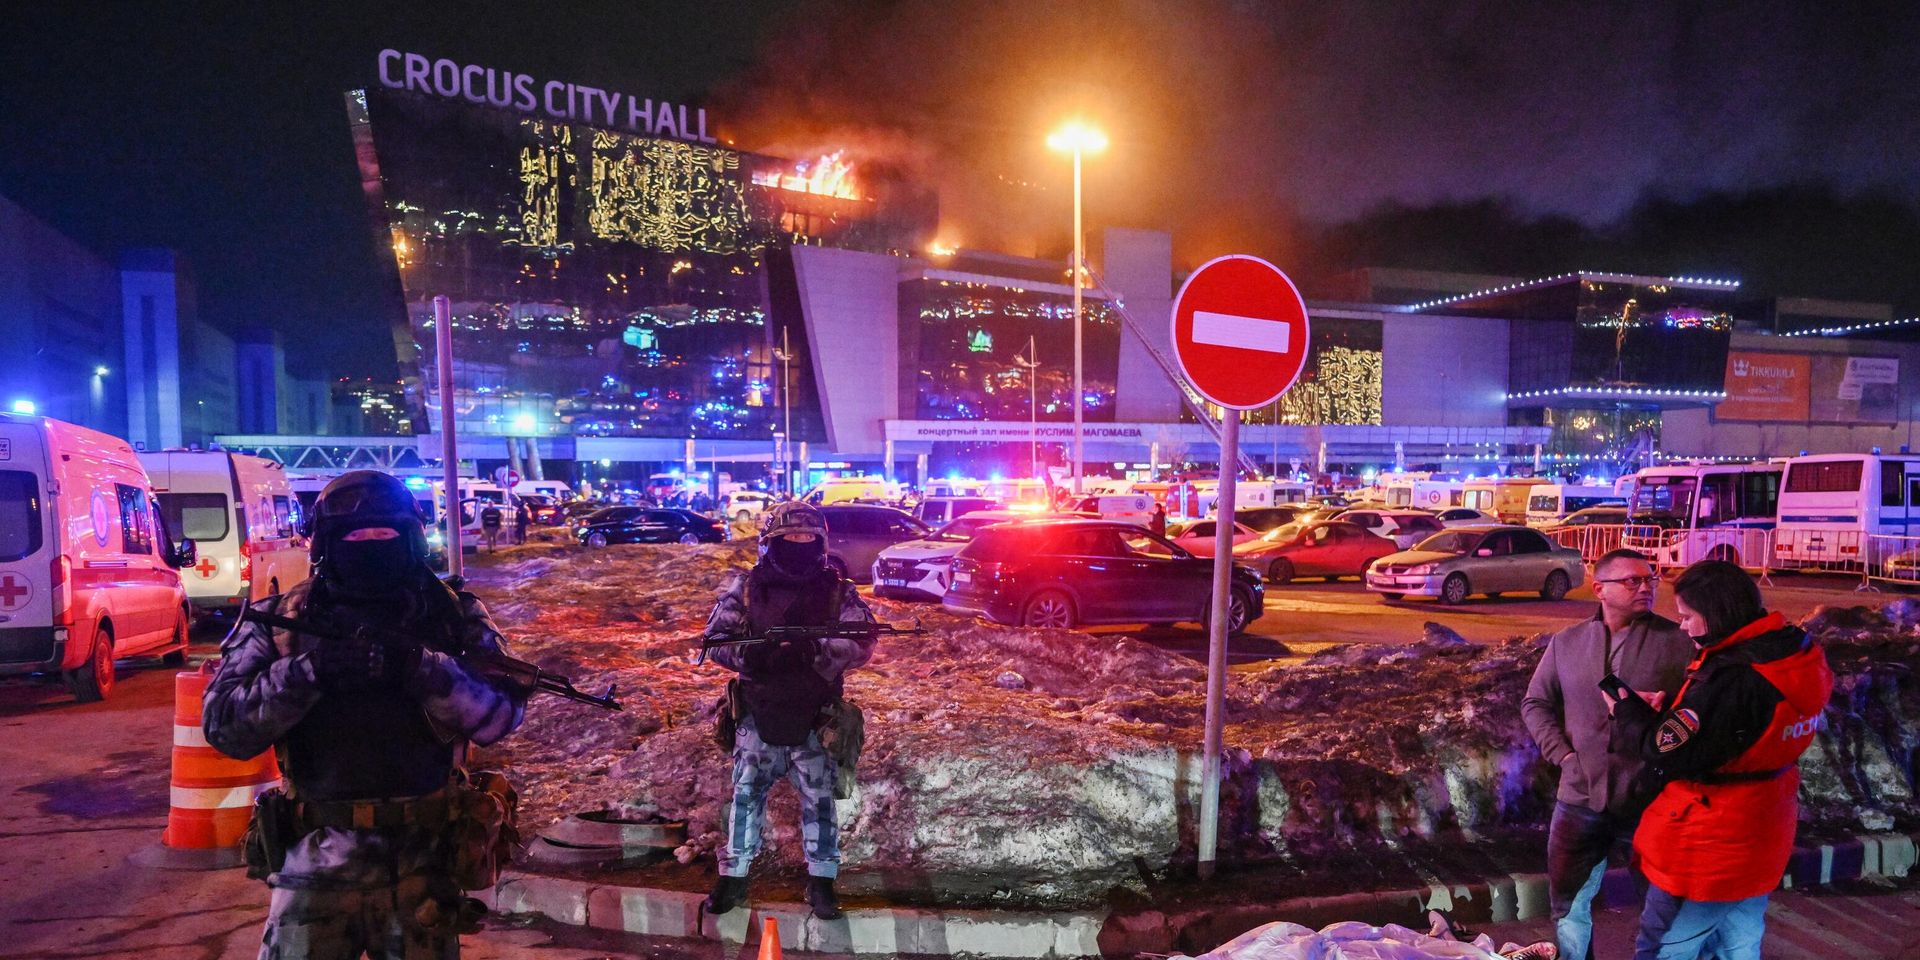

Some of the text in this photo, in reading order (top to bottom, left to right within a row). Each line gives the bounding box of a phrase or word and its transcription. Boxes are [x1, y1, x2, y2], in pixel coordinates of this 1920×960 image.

[378, 48, 717, 144] CROCUS CITY HALL
[917, 426, 978, 437] концертный
[980, 428, 997, 436] зал
[999, 428, 1030, 436] имени
[1082, 428, 1142, 437] МАГОМАЕВА
